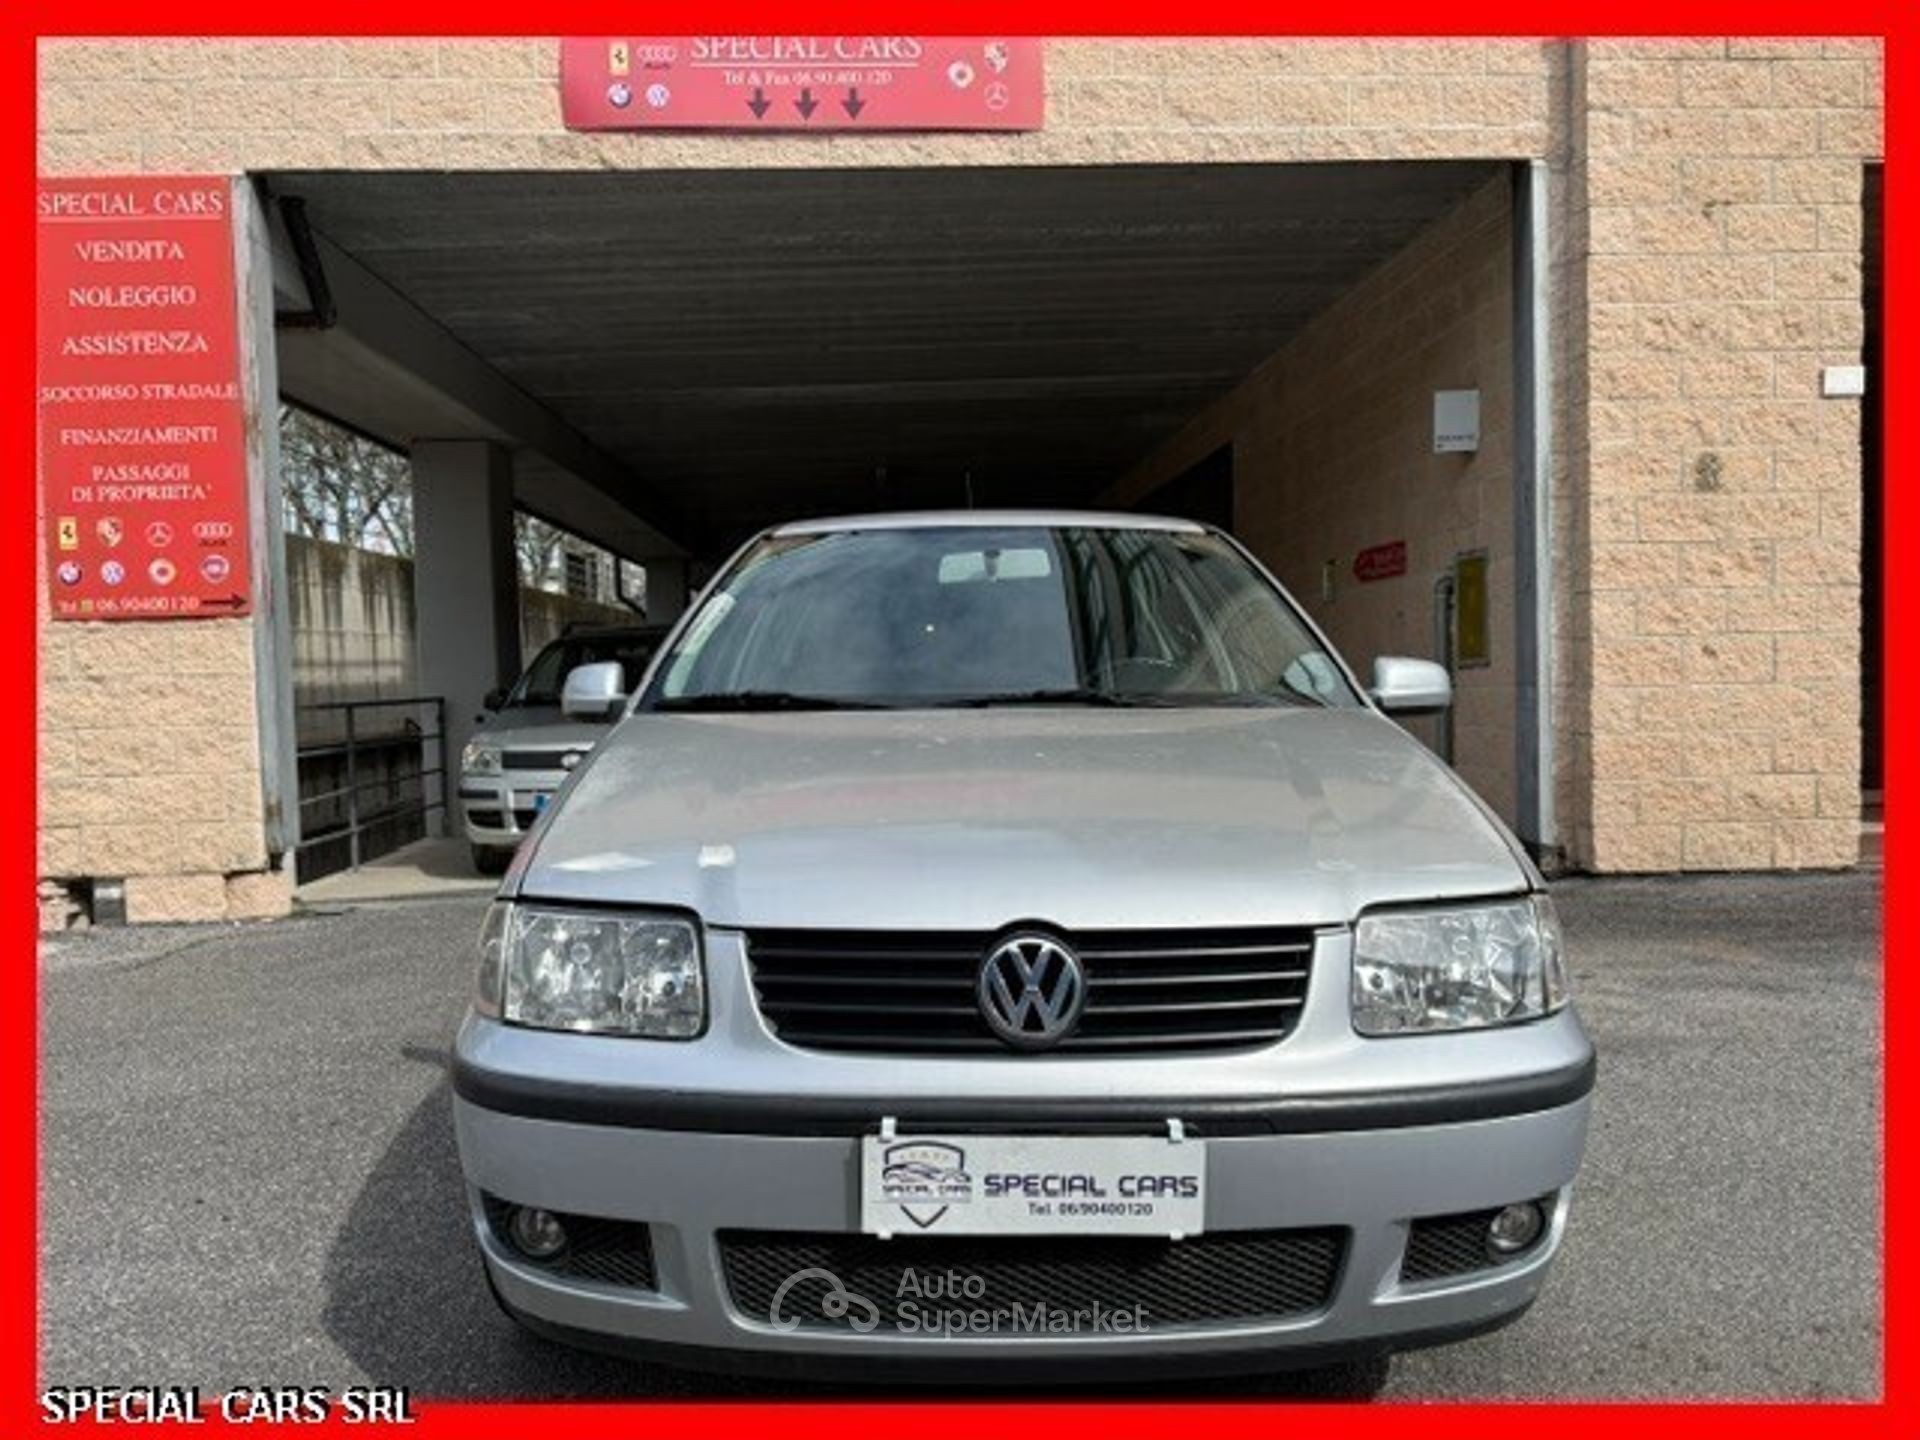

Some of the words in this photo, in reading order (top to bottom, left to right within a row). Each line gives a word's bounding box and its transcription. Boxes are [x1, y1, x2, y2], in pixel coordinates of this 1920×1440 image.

[691, 36, 828, 59] SPECIAL
[834, 36, 922, 59] CARS
[37, 192, 144, 215] SPECIAL
[153, 190, 223, 214] CARS
[75, 240, 184, 263] VENDITA
[68, 285, 197, 308] NOLEGGIO
[62, 331, 209, 356] ASSISTENZA
[41, 385, 138, 401] SOCCORSO
[141, 383, 239, 399] STRADALE
[61, 426, 218, 445] FINANZIAMENTI
[93, 464, 190, 482] PASSAGGI
[72, 486, 93, 502] DI
[984, 1174, 1106, 1197] SPECIAL
[1118, 1175, 1198, 1197] CARS
